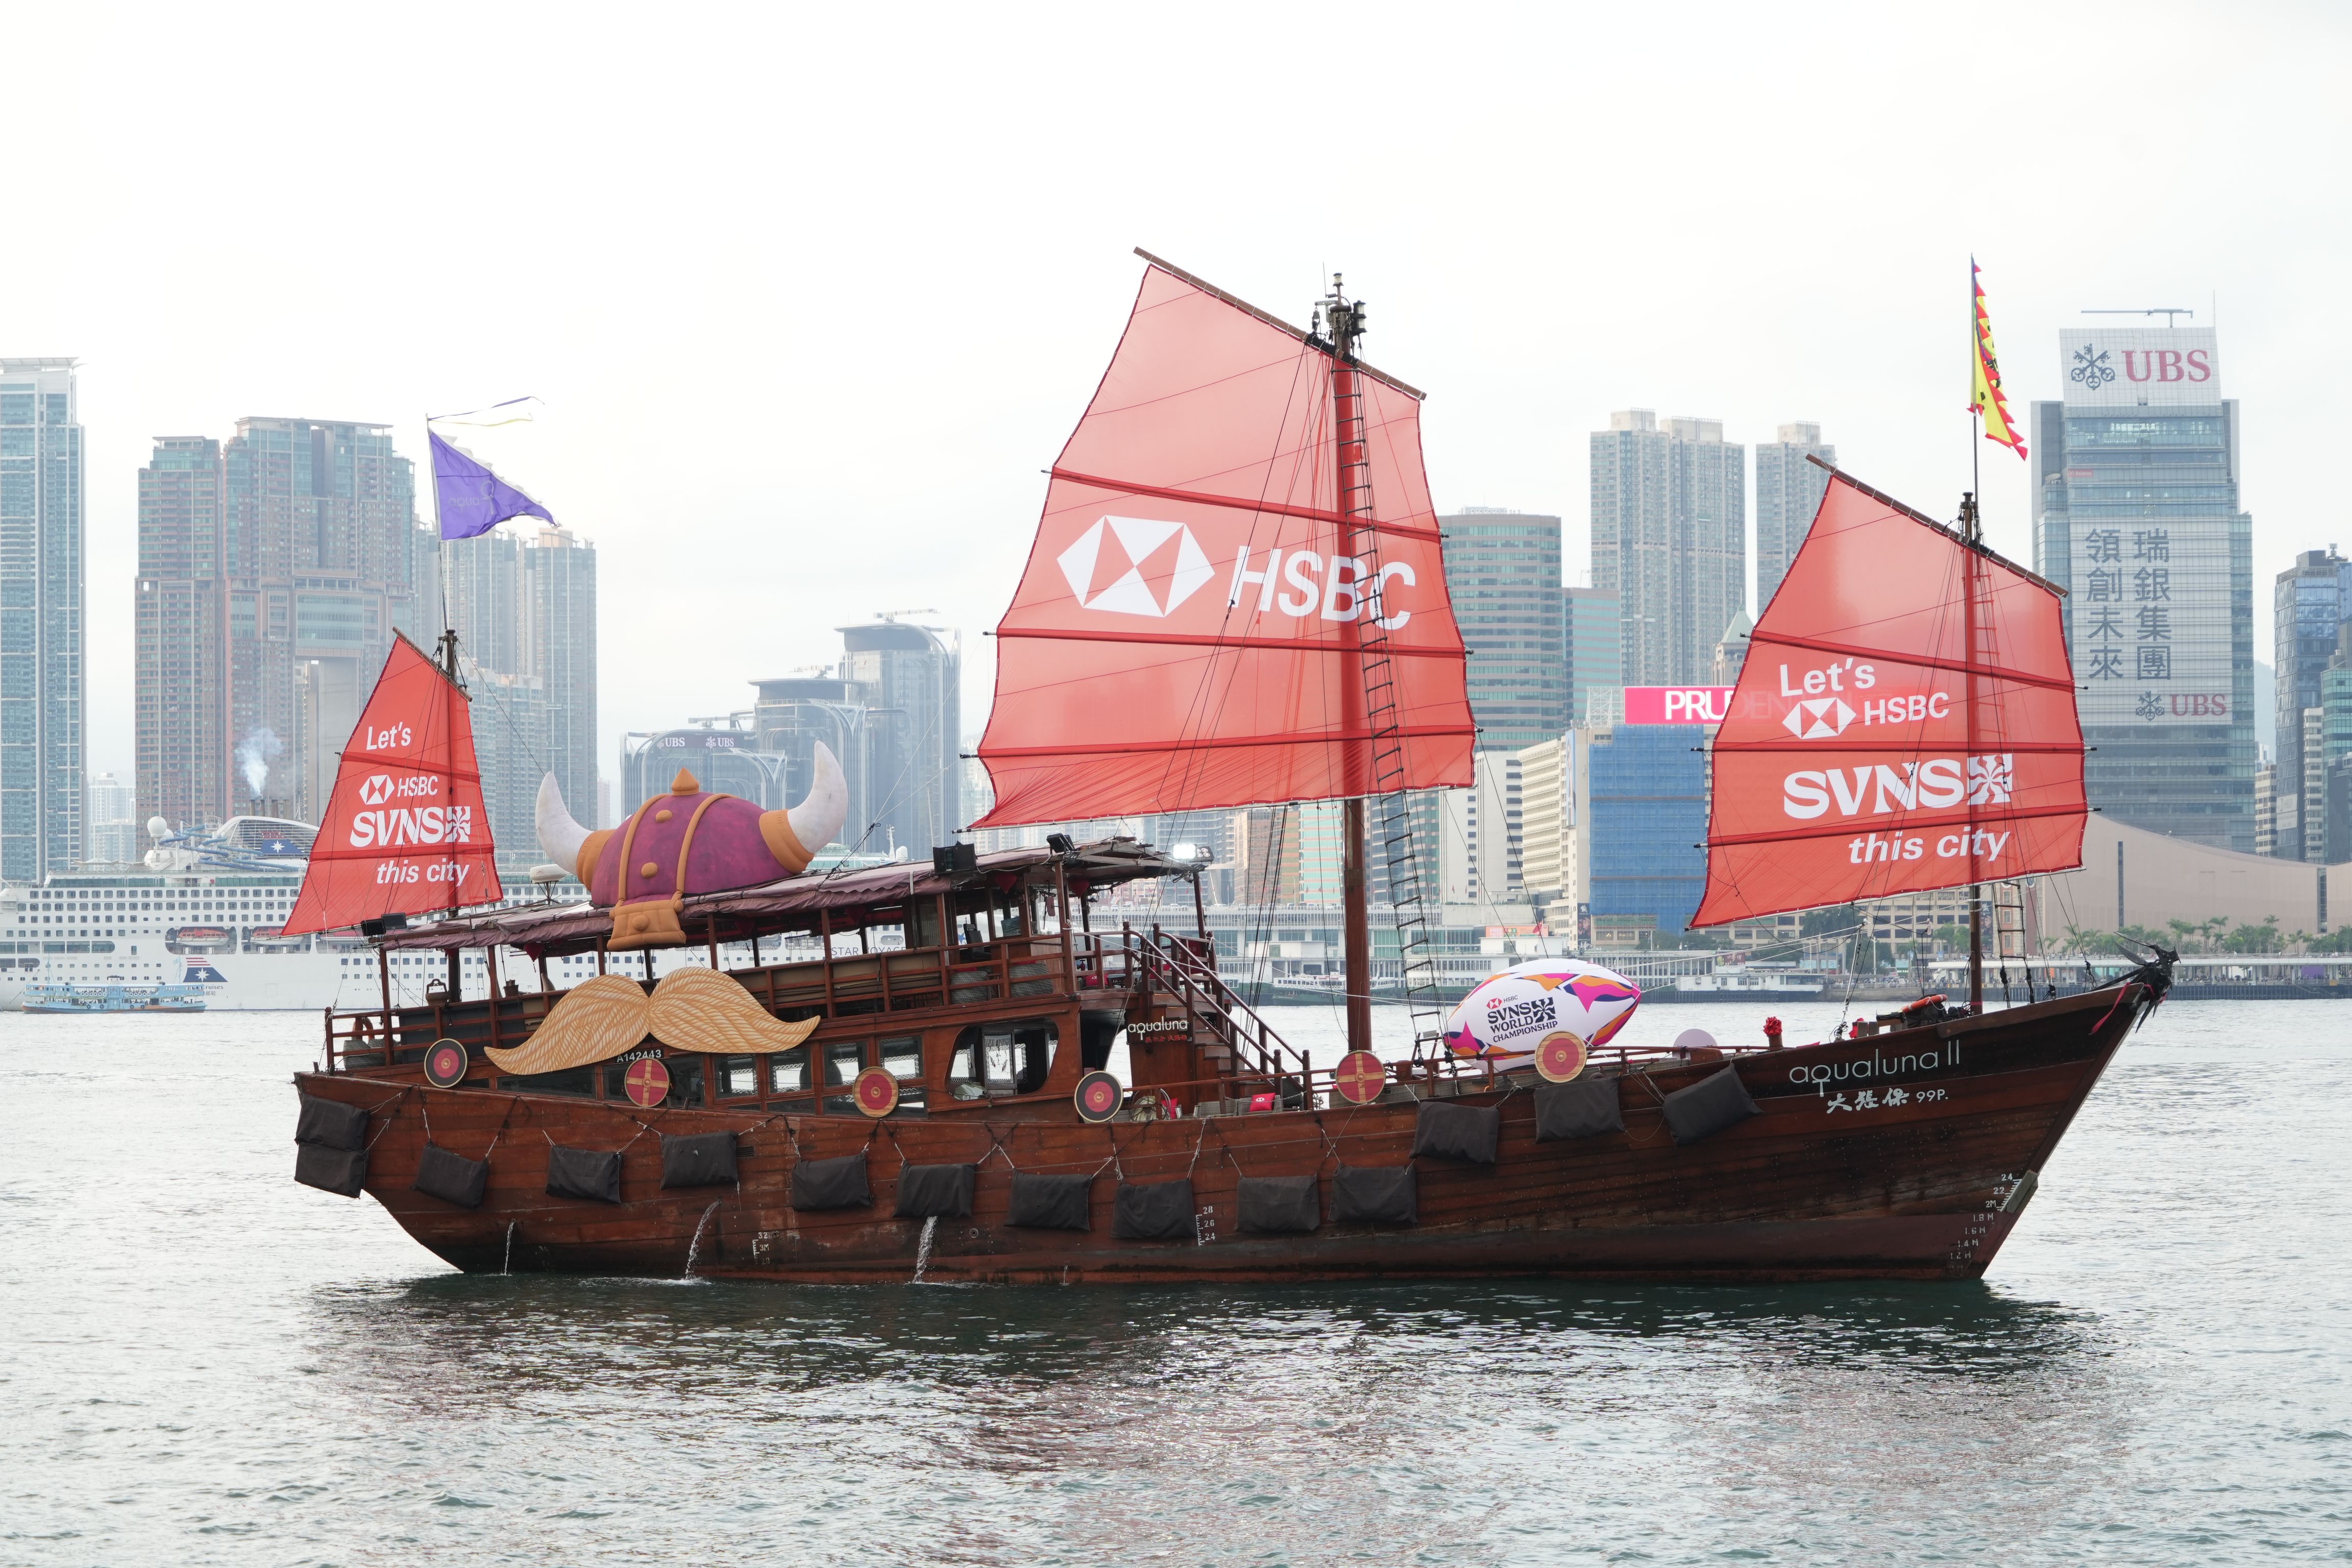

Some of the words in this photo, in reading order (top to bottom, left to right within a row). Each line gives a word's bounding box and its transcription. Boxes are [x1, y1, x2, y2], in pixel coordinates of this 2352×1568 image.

[2121, 350, 2211, 382] UBS
[1227, 546, 1416, 630] HSBC
[2085, 528, 2124, 681] 領創未來
[2133, 528, 2172, 680] 瑞銀集團
[1780, 657, 1876, 697] Let's
[1865, 692, 1949, 725] HSBC
[2170, 694, 2227, 717] UBS
[366, 722, 411, 750] Let's
[665, 738, 685, 747] UBS
[718, 738, 734, 747] UBS
[397, 775, 438, 797] HSBC
[1784, 758, 1965, 819] SVNS
[350, 806, 445, 847] SVNS
[1849, 832, 1923, 864] this
[1937, 826, 2011, 862] city
[377, 860, 419, 884] this
[427, 857, 470, 887] city
[831, 947, 859, 955] STAR
[1487, 1002, 1532, 1024] SVNS
[1490, 1016, 1533, 1034] WORLD
[1128, 1016, 1188, 1040] aqualuna
[1493, 1021, 1558, 1043] CHAMPIONSHIP
[617, 1049, 662, 1063] A142443
[1789, 1048, 1939, 1097] aqualuna
